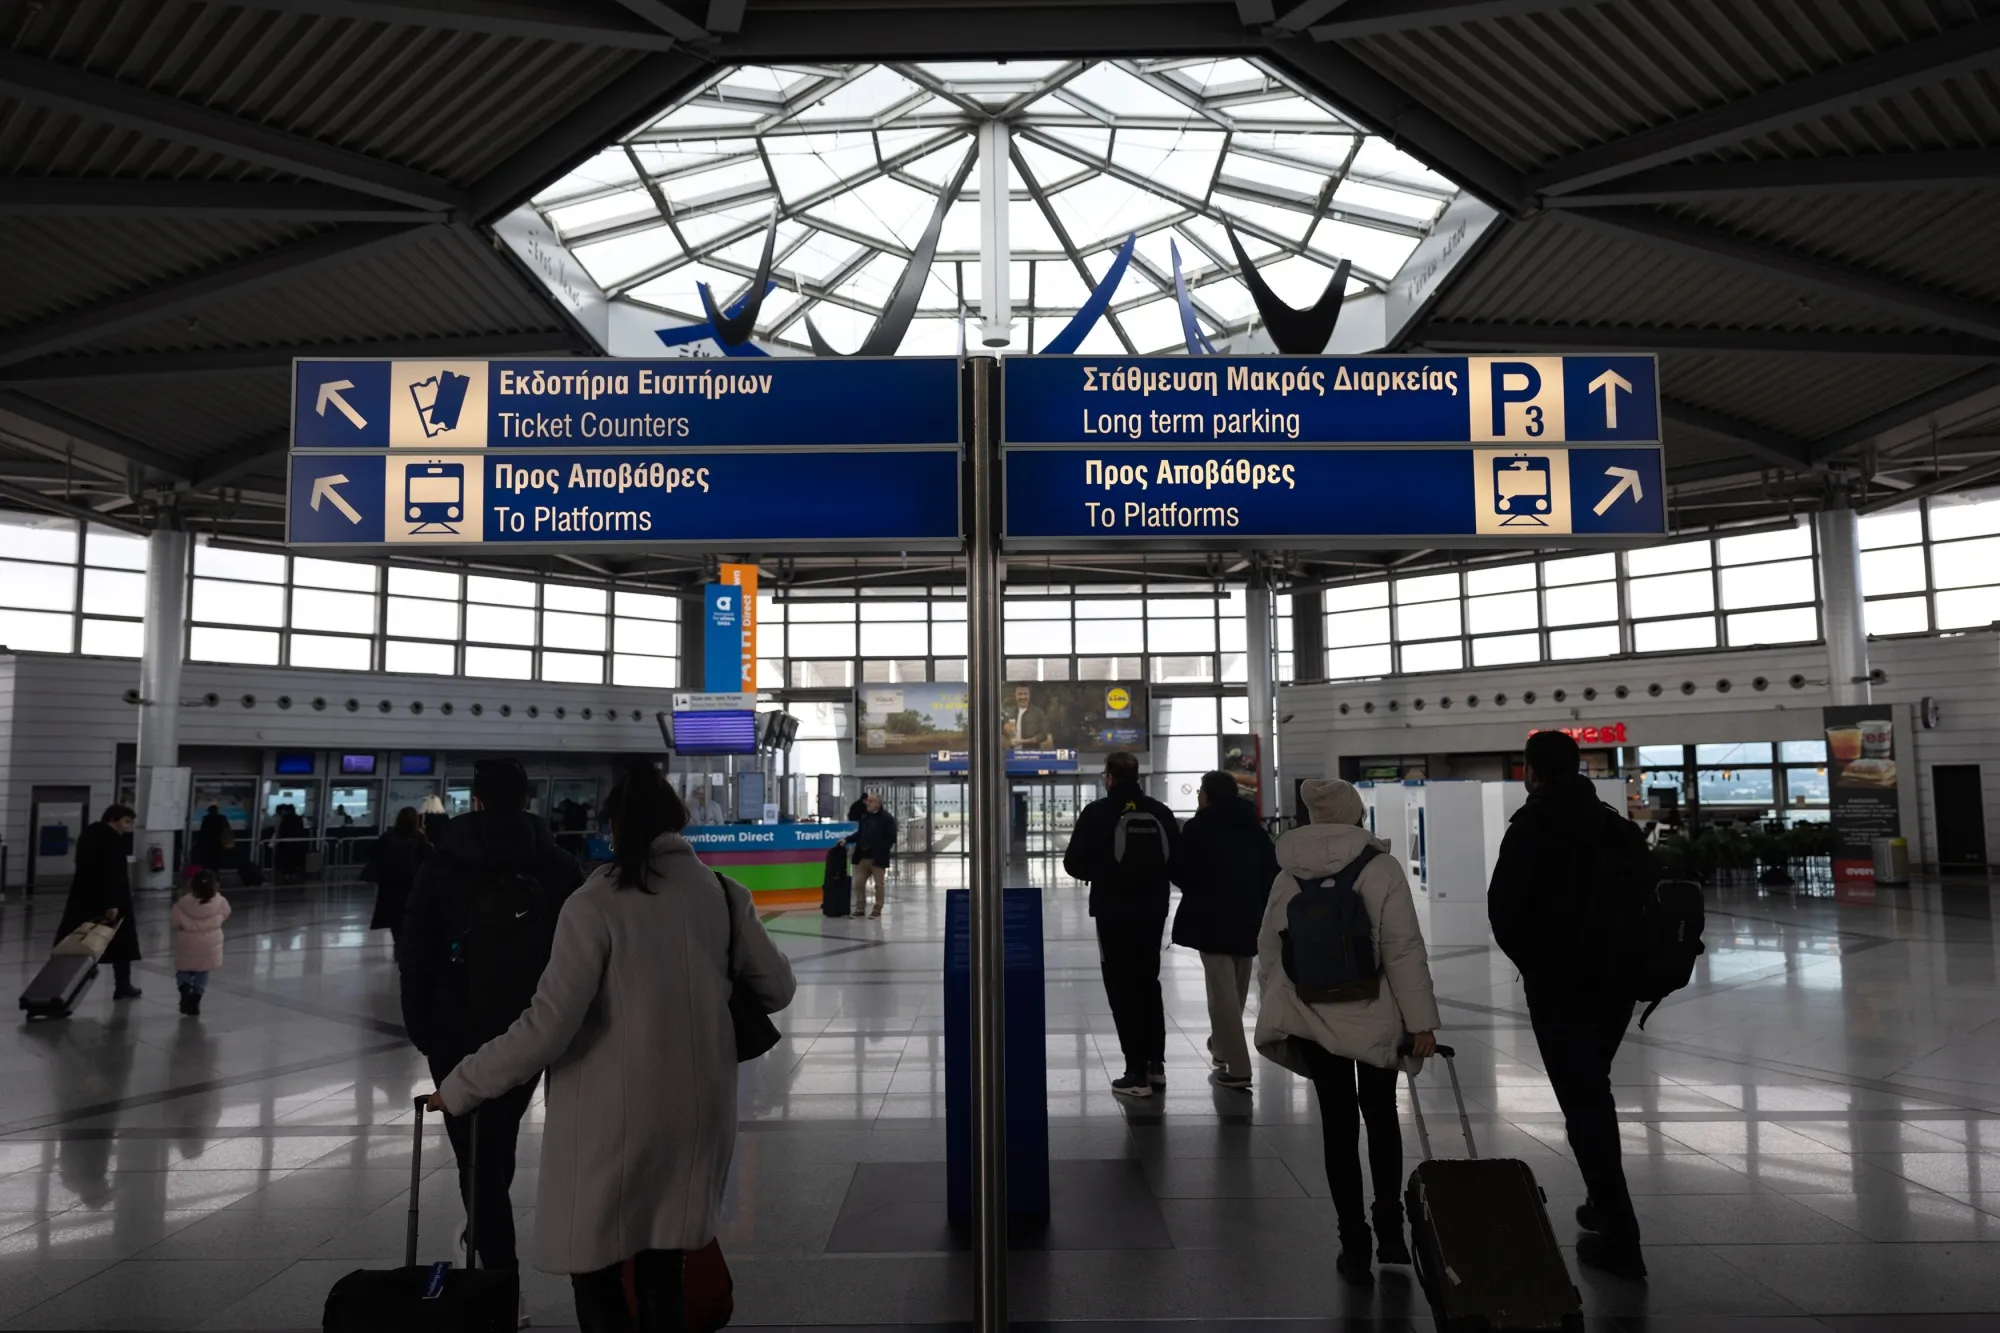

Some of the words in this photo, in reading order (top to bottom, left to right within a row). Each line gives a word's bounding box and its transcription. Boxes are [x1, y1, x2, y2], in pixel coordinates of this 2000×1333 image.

[499, 369, 629, 401] Εκδοτήρια
[638, 369, 773, 400] Εισιτήριων
[1083, 366, 1218, 397] Στάθμευση
[1227, 365, 1325, 397] Μακράς
[1333, 365, 1458, 397] Διαρκείας
[498, 412, 573, 438] Ticket
[580, 411, 690, 438] Counters
[1083, 408, 1142, 439] Long
[1149, 409, 1204, 434] term
[1213, 408, 1300, 439] parking
[495, 463, 560, 494] Προς
[567, 462, 710, 494] Αποβάθρες
[1085, 459, 1148, 491] Προς
[1156, 458, 1296, 490] Αποβάθρες
[493, 506, 525, 533] To
[534, 505, 652, 532] Platforms
[1084, 502, 1116, 528] To
[1124, 501, 1239, 528] Platforms
[742, 594, 752, 627] Direct
[1528, 722, 1627, 743] erest
[682, 832, 736, 844] owntown
[738, 831, 775, 843] Direct
[795, 830, 823, 841] Travel
[1845, 865, 1874, 877] ever
